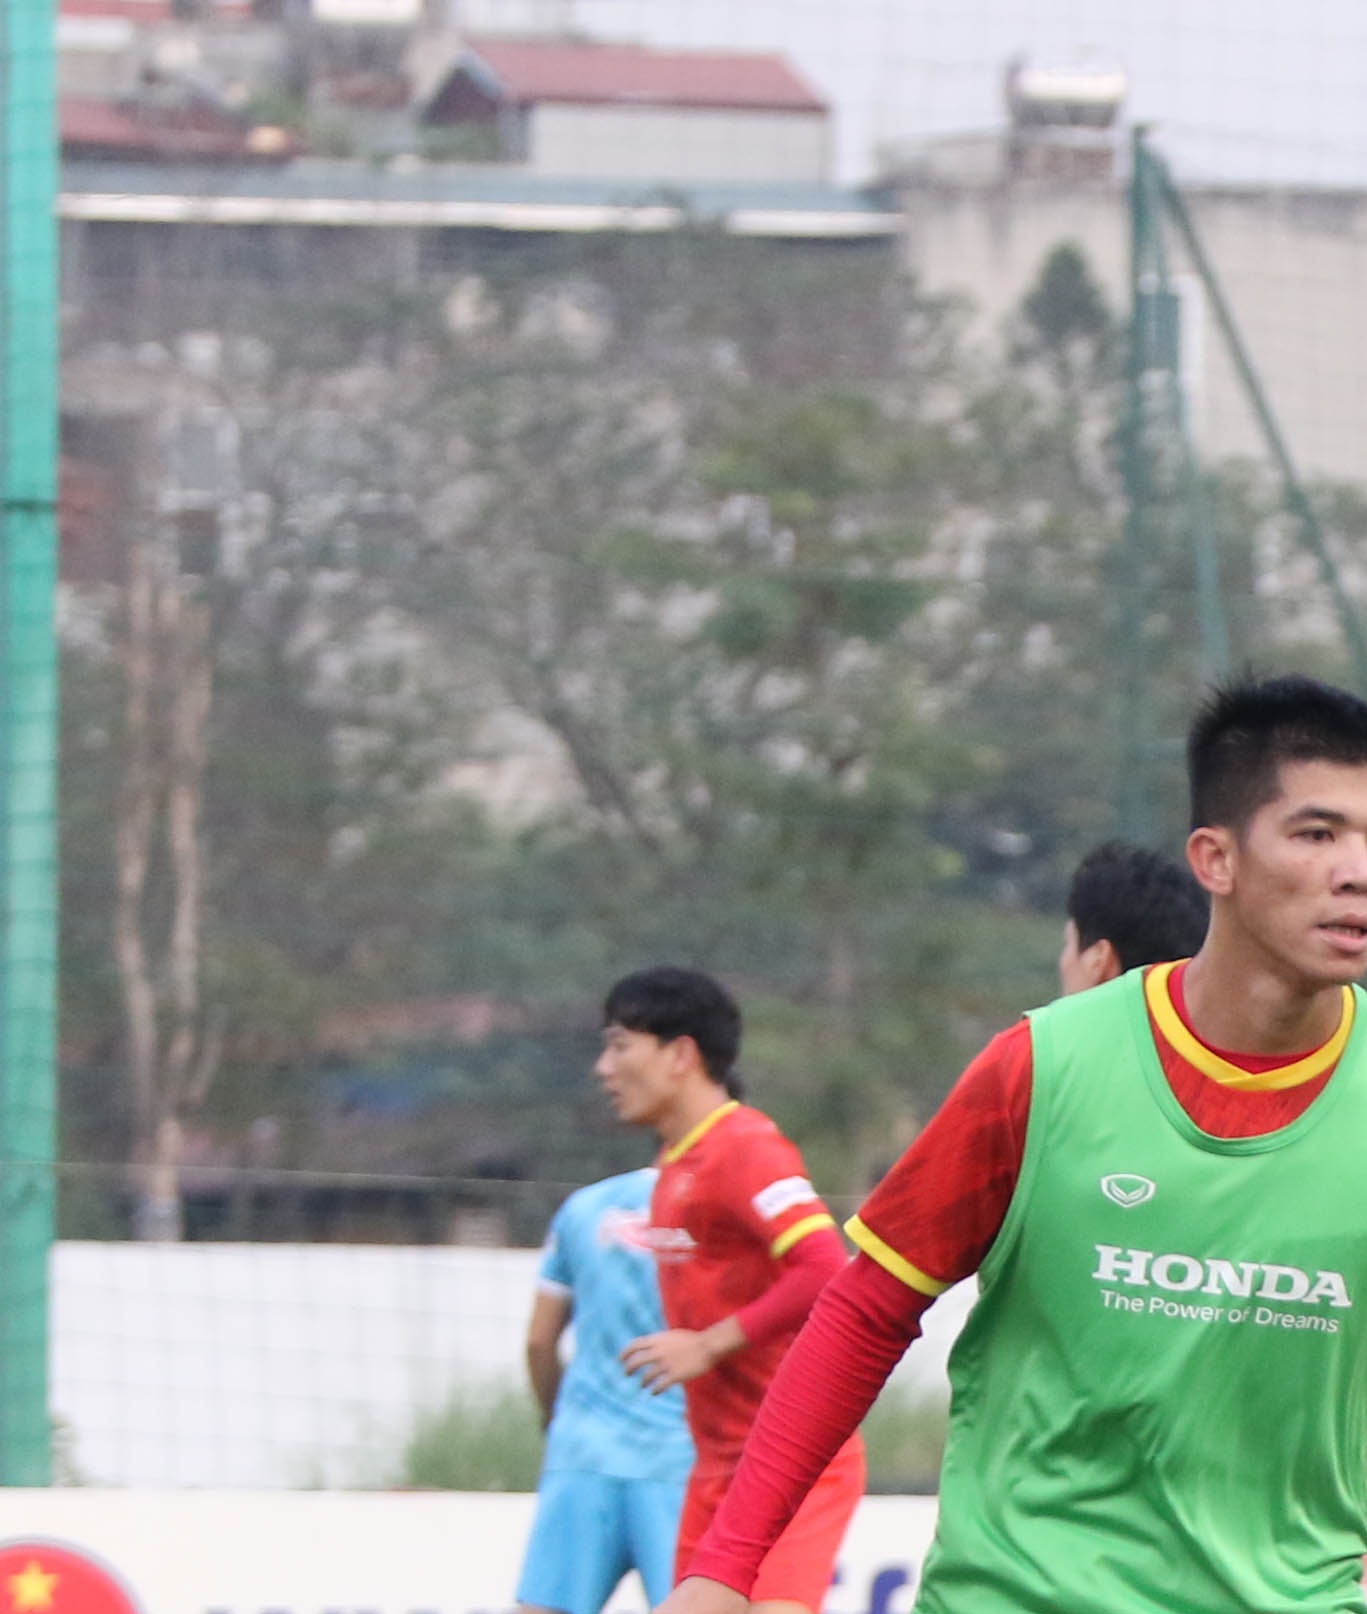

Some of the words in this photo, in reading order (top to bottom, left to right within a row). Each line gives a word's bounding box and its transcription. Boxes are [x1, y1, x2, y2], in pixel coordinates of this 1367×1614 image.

[1092, 1244, 1352, 1307] HONDA
[1100, 1288, 1145, 1313] The
[1150, 1296, 1224, 1322] Power
[1228, 1306, 1250, 1323] of
[1254, 1306, 1339, 1334] Dreams
